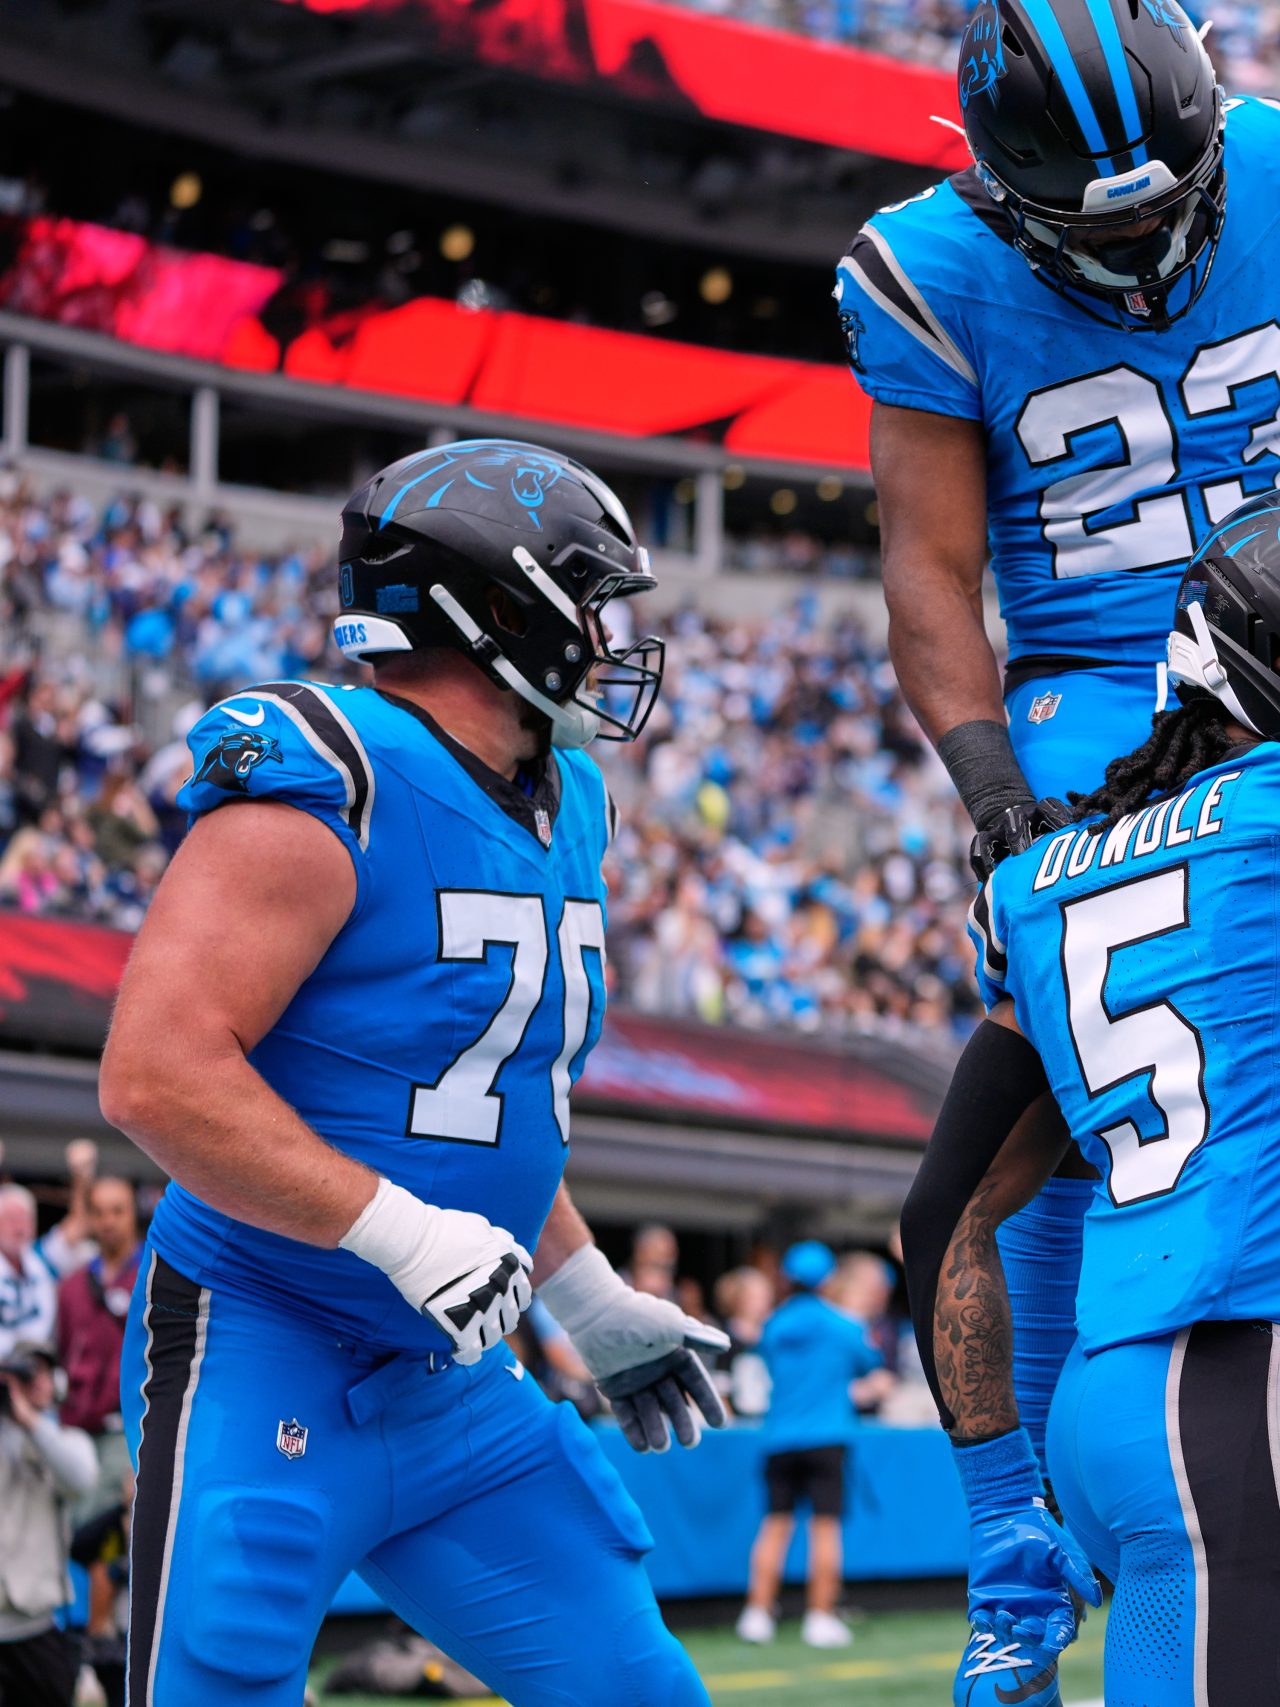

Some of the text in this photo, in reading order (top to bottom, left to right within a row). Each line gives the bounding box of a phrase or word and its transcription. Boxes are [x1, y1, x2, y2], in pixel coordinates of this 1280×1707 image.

[1106, 175, 1151, 199] CAROLINA
[1032, 769, 1245, 894] DOWDLE
[405, 887, 607, 1150] 70
[1059, 860, 1211, 1209] 5
[283, 1435, 303, 1453] NFL
